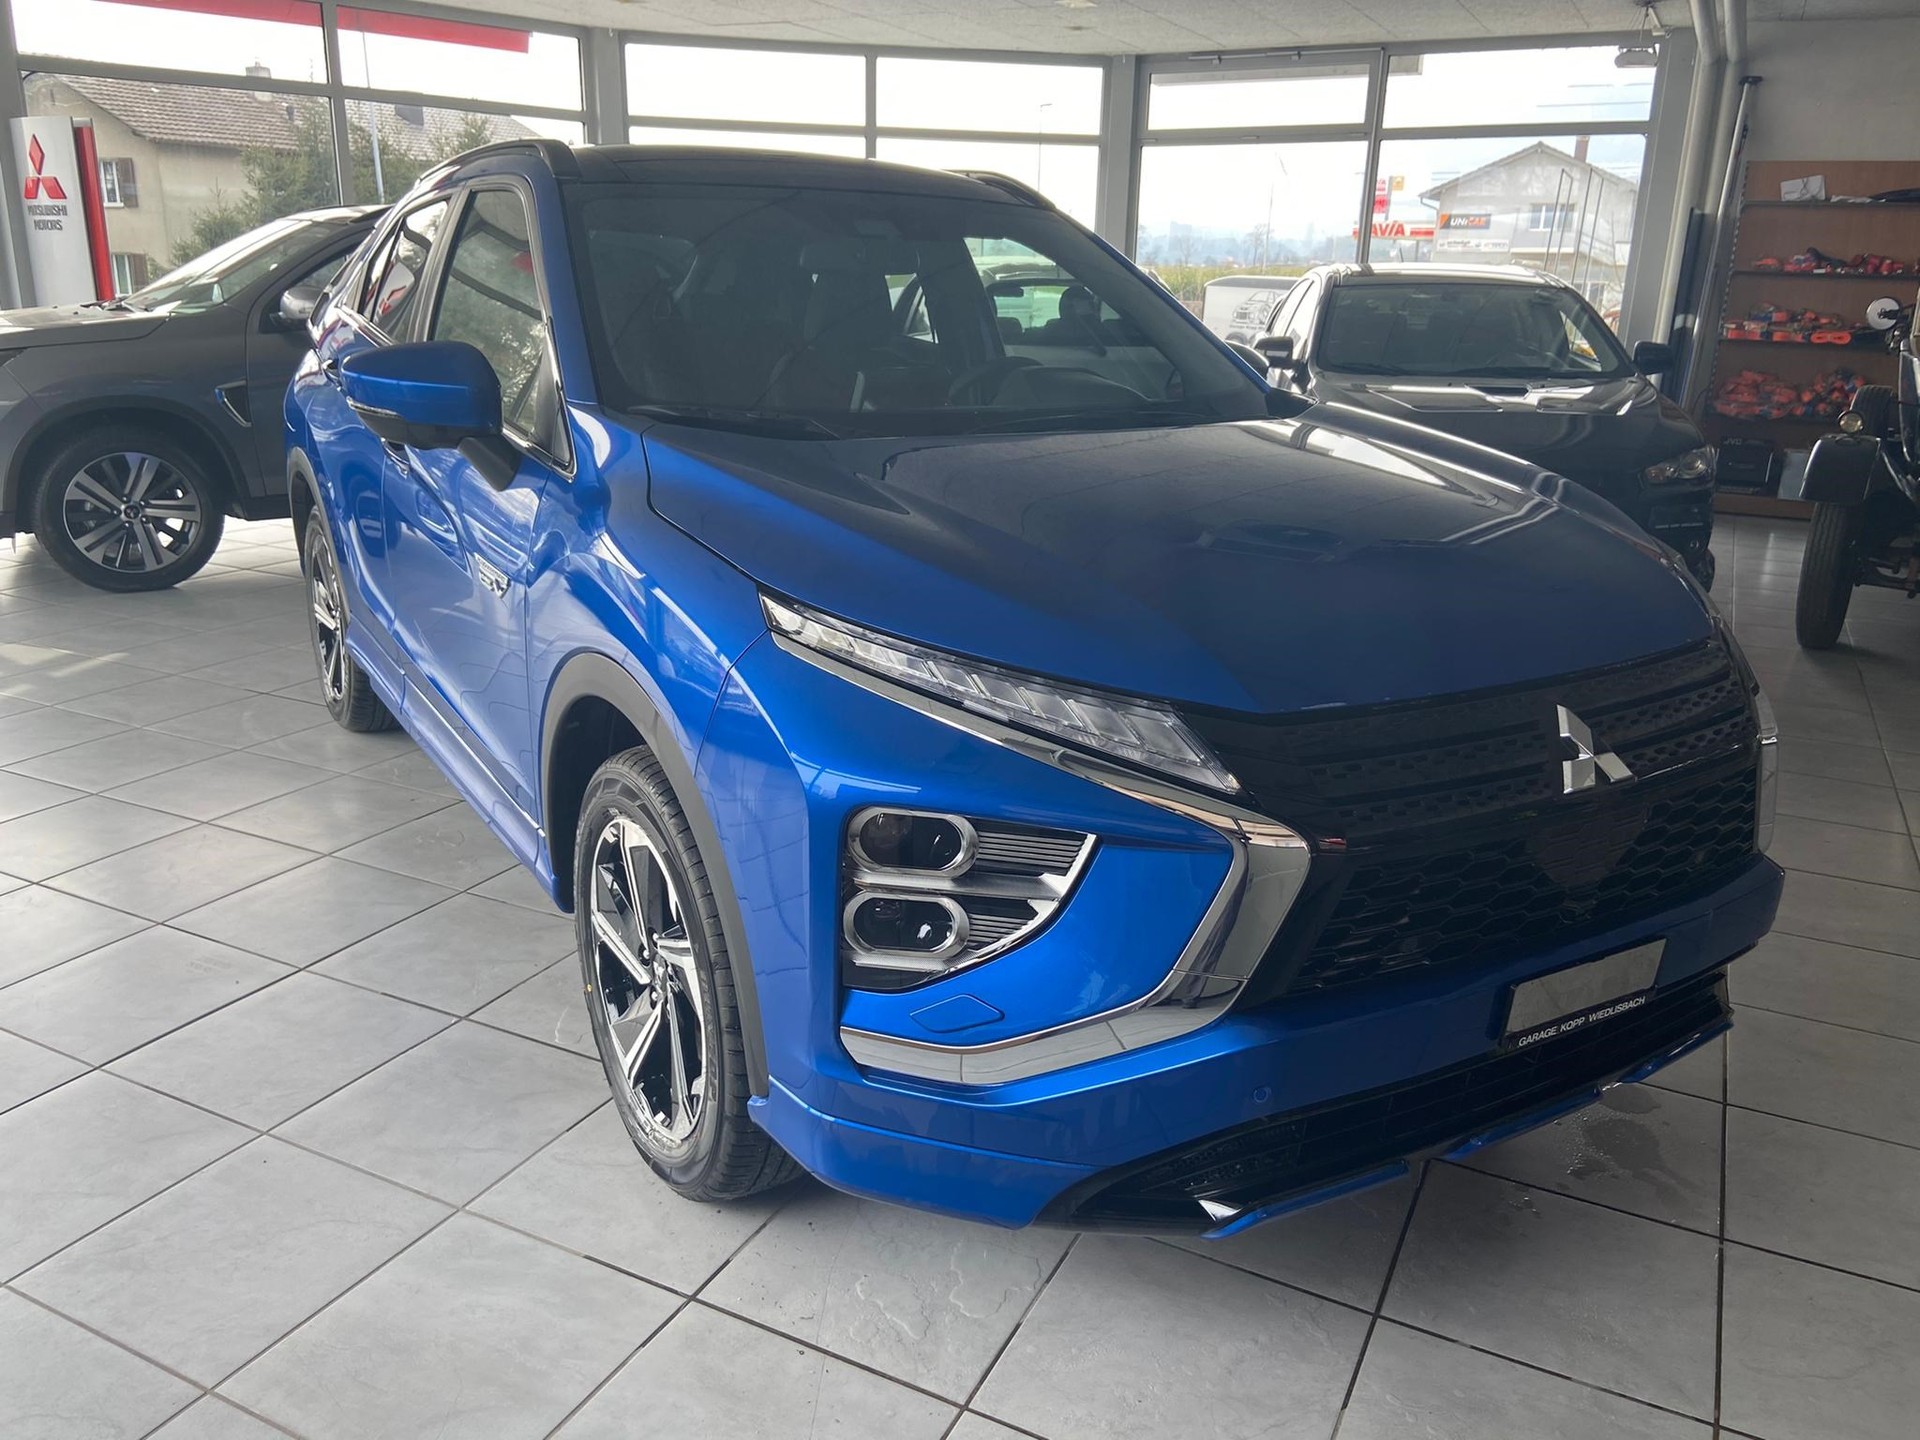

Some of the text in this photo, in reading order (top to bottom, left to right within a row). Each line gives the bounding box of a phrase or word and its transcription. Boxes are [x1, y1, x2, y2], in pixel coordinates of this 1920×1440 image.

[33, 219, 63, 231] MOTORS
[1518, 995, 1646, 1047] GARAGE KOPP WIEDLISBACH
